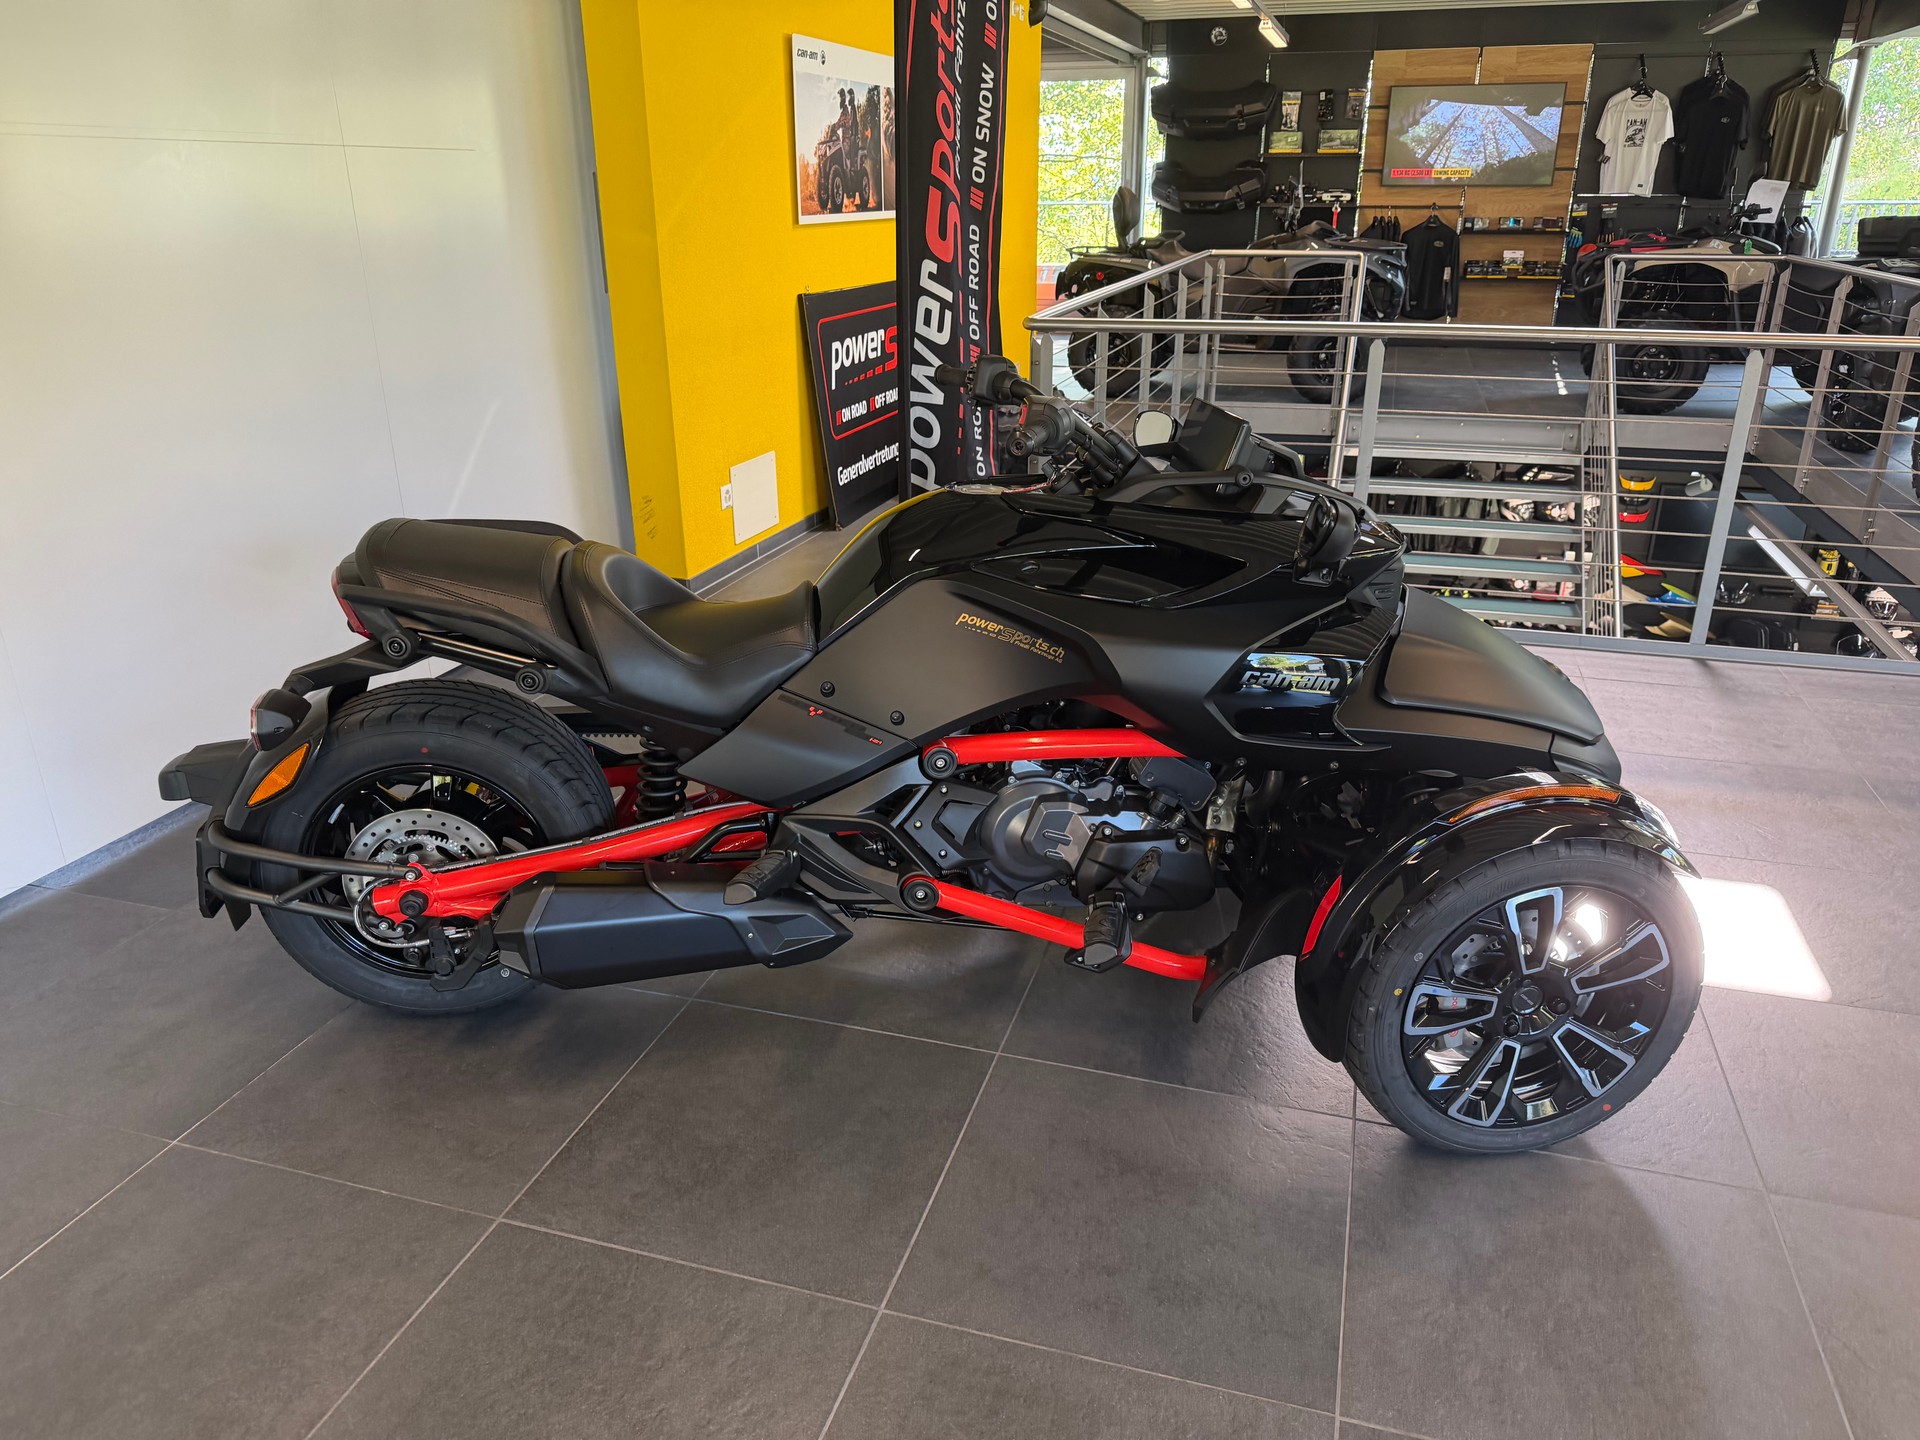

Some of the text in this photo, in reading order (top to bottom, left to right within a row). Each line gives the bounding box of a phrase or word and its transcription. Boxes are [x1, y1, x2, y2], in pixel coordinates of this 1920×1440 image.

[976, 62, 996, 143] SNOW
[971, 147, 988, 184] ON
[968, 224, 980, 291] ROAD
[969, 296, 980, 340] OFF
[841, 404, 851, 423] ON
[851, 399, 867, 420] ROAD
[874, 393, 885, 409] OFF
[976, 446, 986, 476] ON
